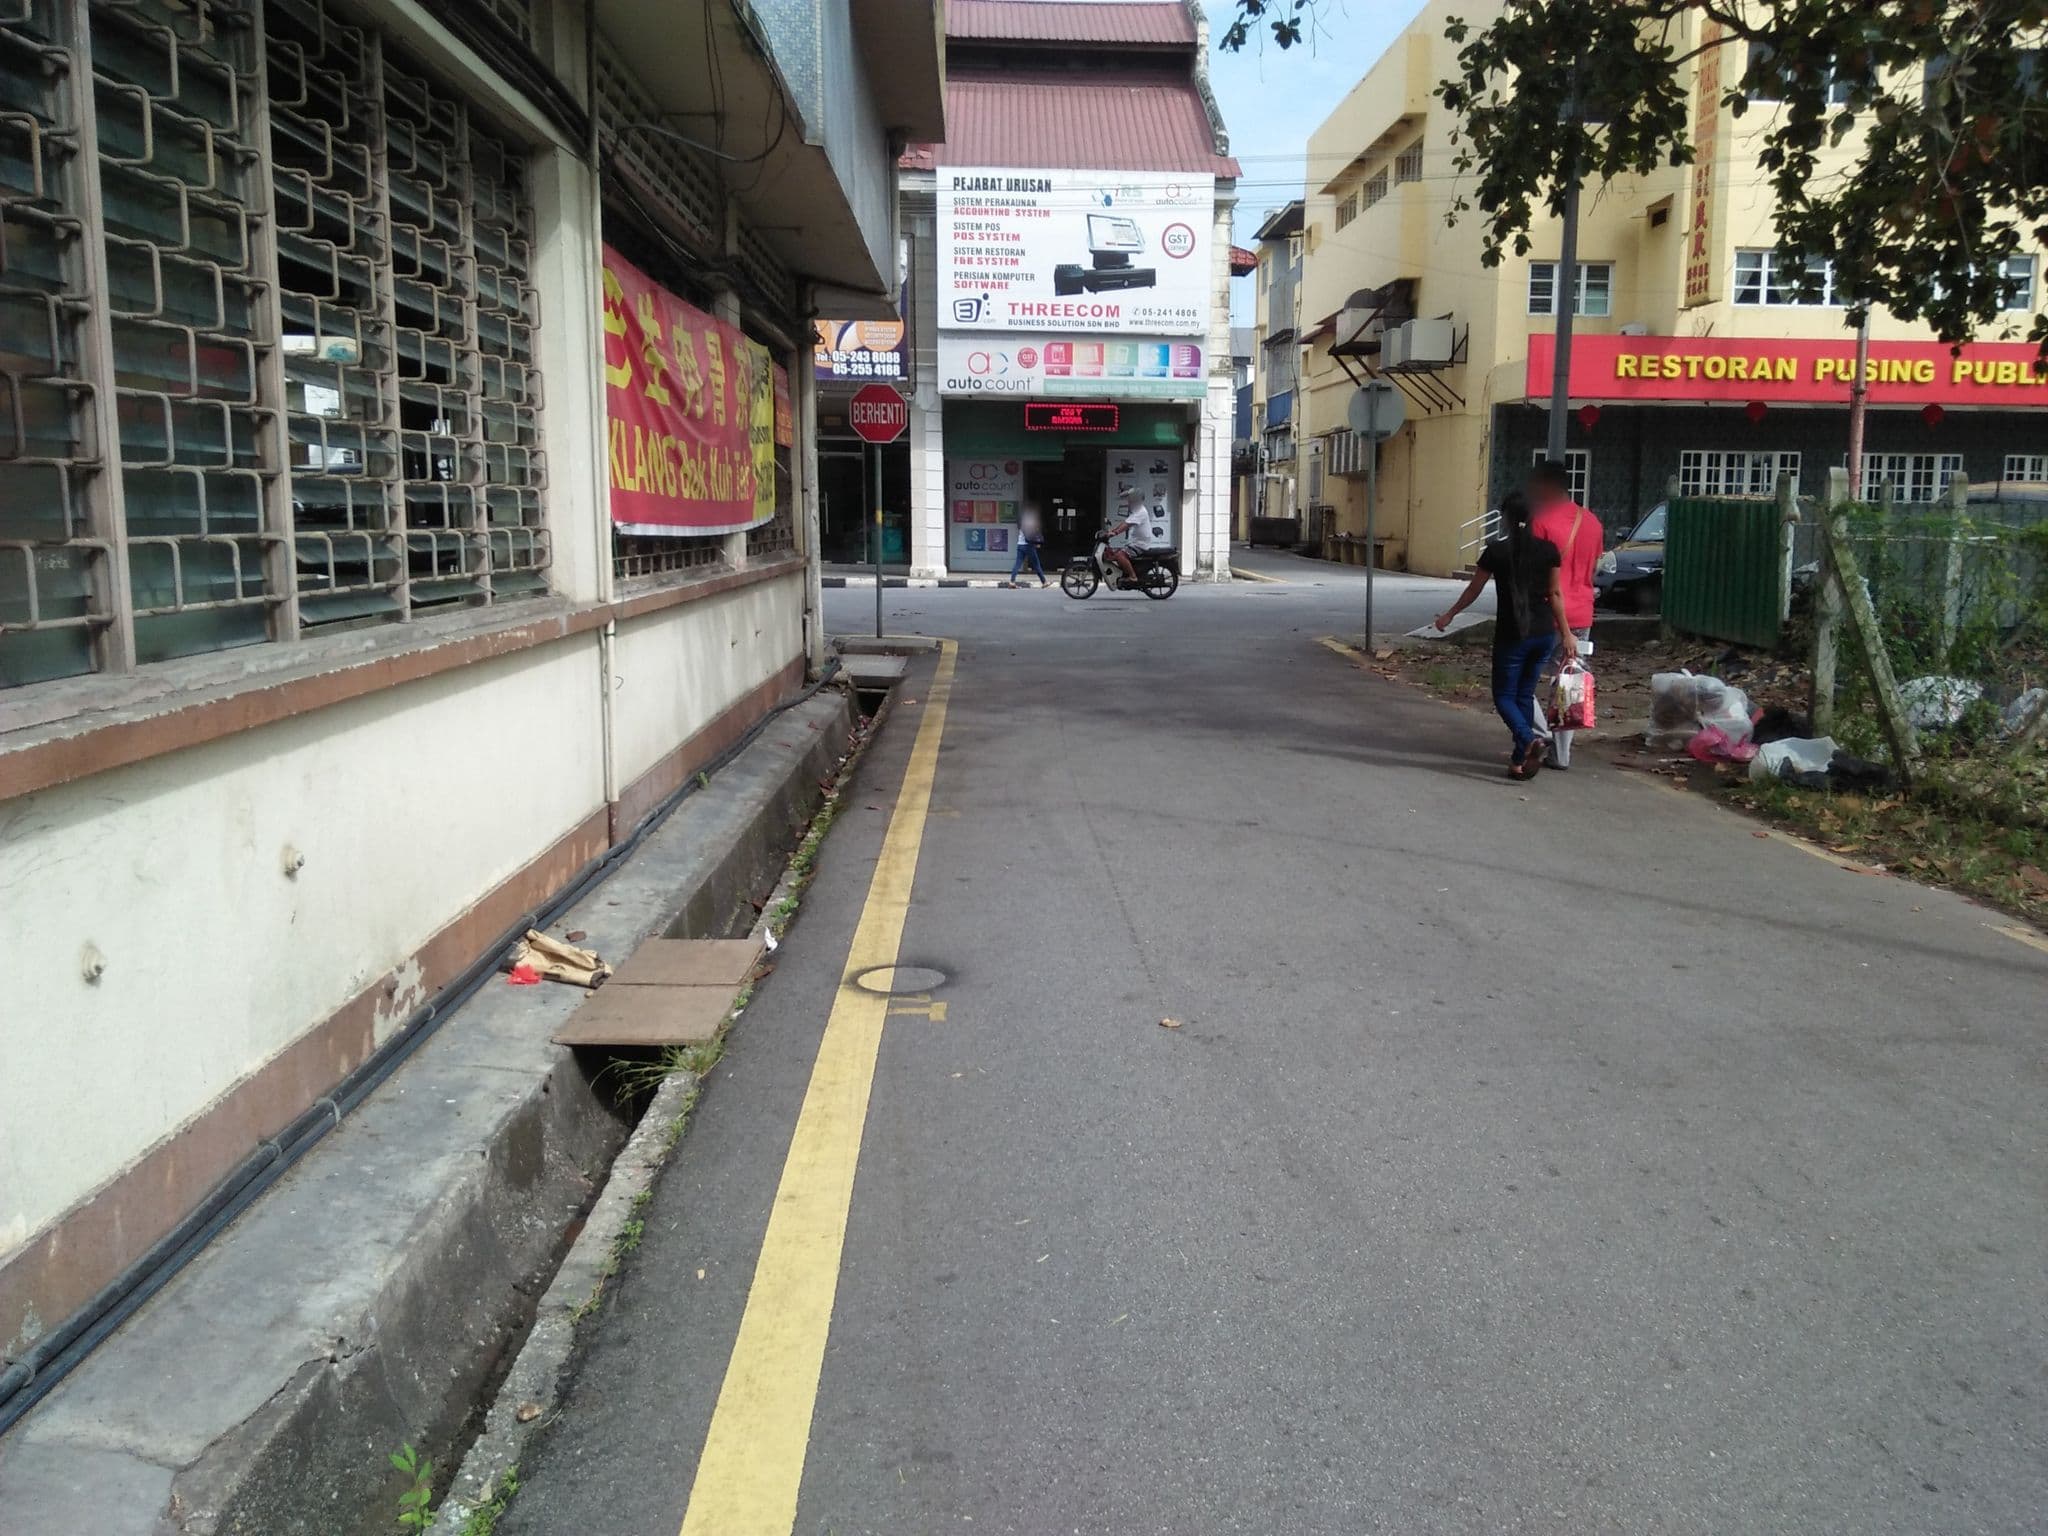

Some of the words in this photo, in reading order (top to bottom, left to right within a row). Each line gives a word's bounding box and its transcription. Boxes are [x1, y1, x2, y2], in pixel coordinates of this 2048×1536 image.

[953, 177, 1003, 191] PEJABAT
[1006, 178, 1052, 192] URUSAN
[953, 197, 982, 206] SISTEM
[985, 198, 1037, 207] PERAKAUNAN
[1016, 208, 1050, 217] SYSTEM
[953, 222, 982, 231] SISTEM
[985, 223, 1001, 231] POS
[954, 232, 974, 240] POS
[978, 233, 1020, 241] SYSTEM
[1168, 234, 1188, 245] GST
[953, 247, 982, 256] SISTEM
[985, 248, 1026, 257] RESTORAN
[977, 257, 1019, 266] SYSTEM
[954, 271, 989, 280] PERISIAN
[993, 272, 1035, 281] KOMPUTER
[954, 280, 1009, 290] SOFTWARE
[1008, 302, 1120, 318] THREECOM
[1142, 308, 1173, 317] 05-241
[1175, 309, 1197, 318] 4806
[1008, 319, 1046, 327] BUSINESS
[1047, 319, 1085, 328] SOLUTION
[1087, 320, 1102, 328] SDN
[1104, 320, 1120, 328] BHD
[832, 350, 870, 363] 05-243
[872, 351, 900, 364] 8088
[832, 363, 873, 375] 05-255
[1616, 353, 1798, 381] RESTORAN
[1814, 357, 1935, 383] PUSING
[853, 402, 904, 424] BERHENTI
[607, 416, 677, 498] KLANG
[678, 439, 708, 500] Bak
[710, 446, 733, 502] Kuh
